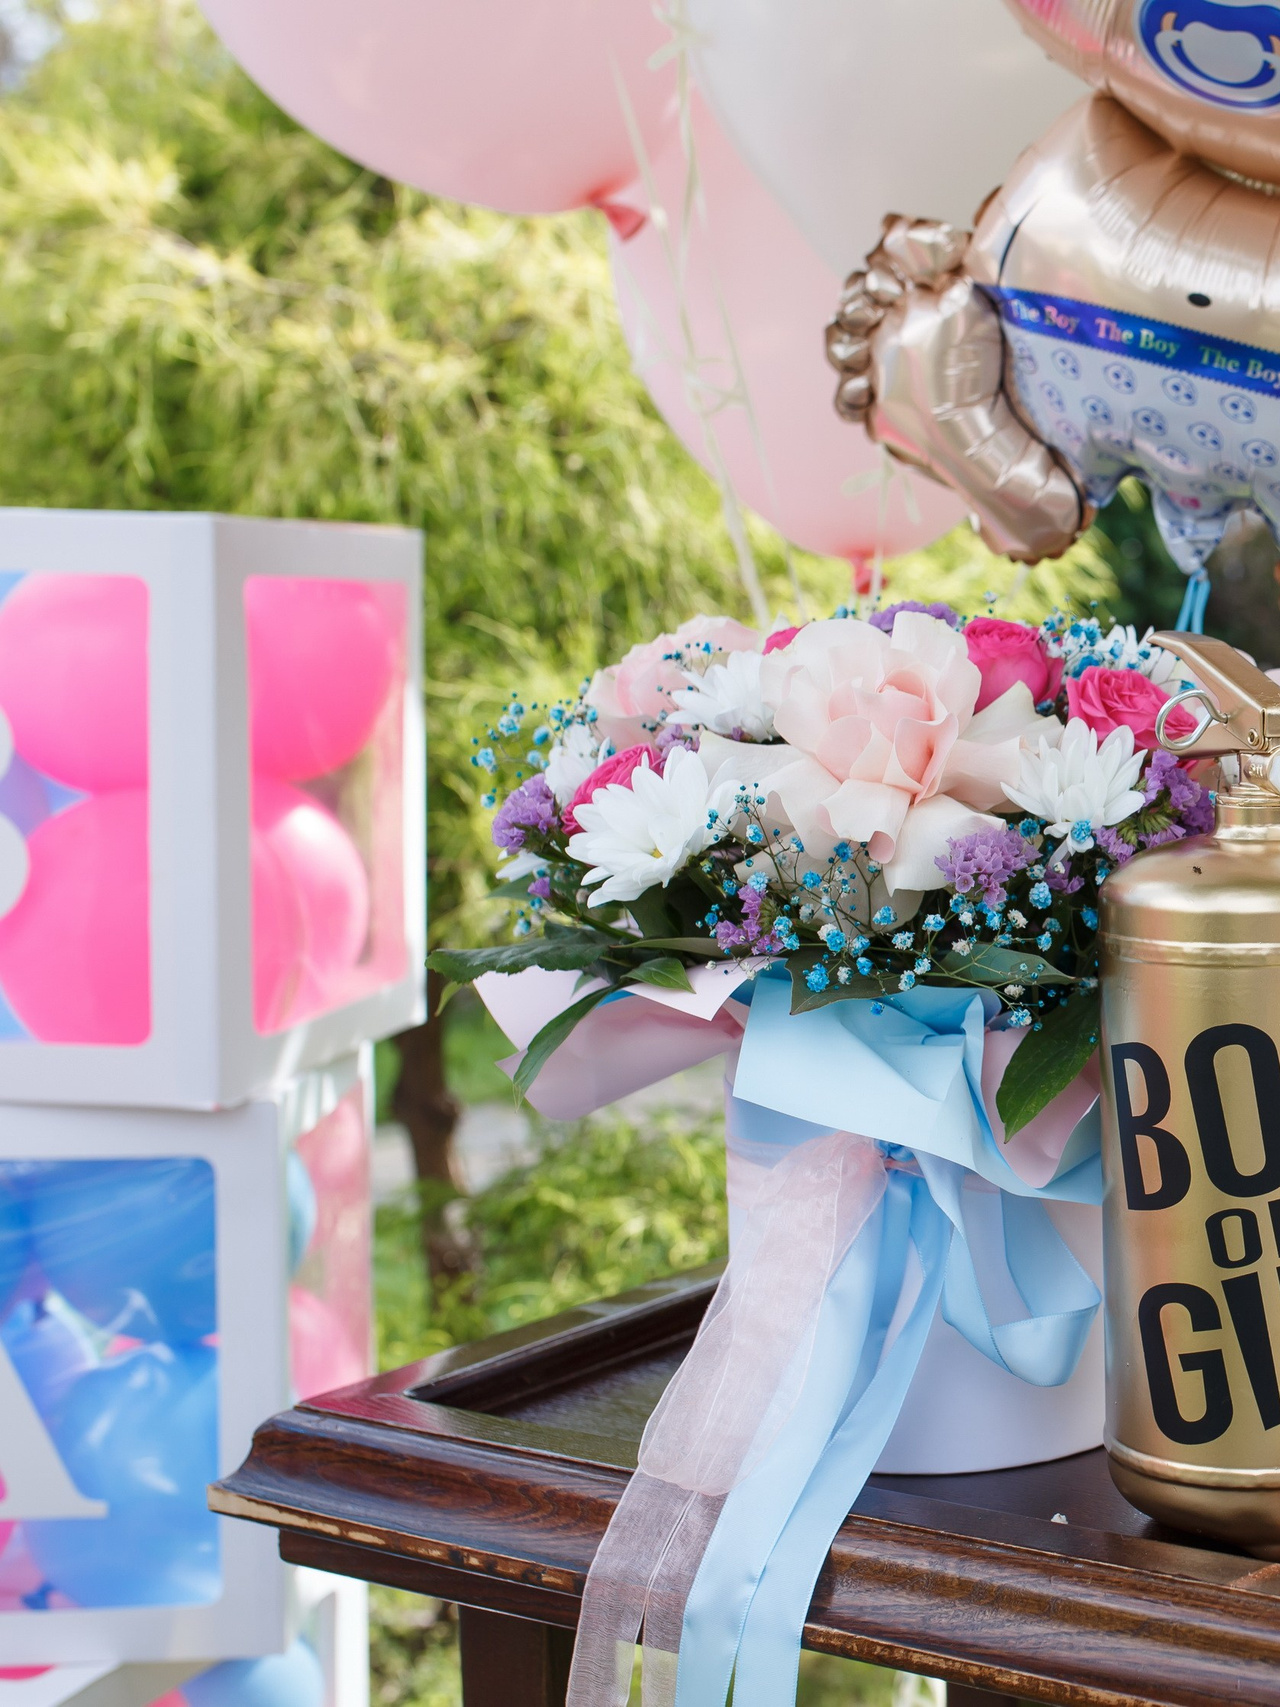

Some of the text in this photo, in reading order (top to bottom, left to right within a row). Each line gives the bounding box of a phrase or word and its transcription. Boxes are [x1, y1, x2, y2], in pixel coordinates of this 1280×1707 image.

[1044, 304, 1080, 334] Boy
[1095, 317, 1134, 344] The
[1139, 328, 1181, 359] Boy
[1200, 346, 1240, 374] The
